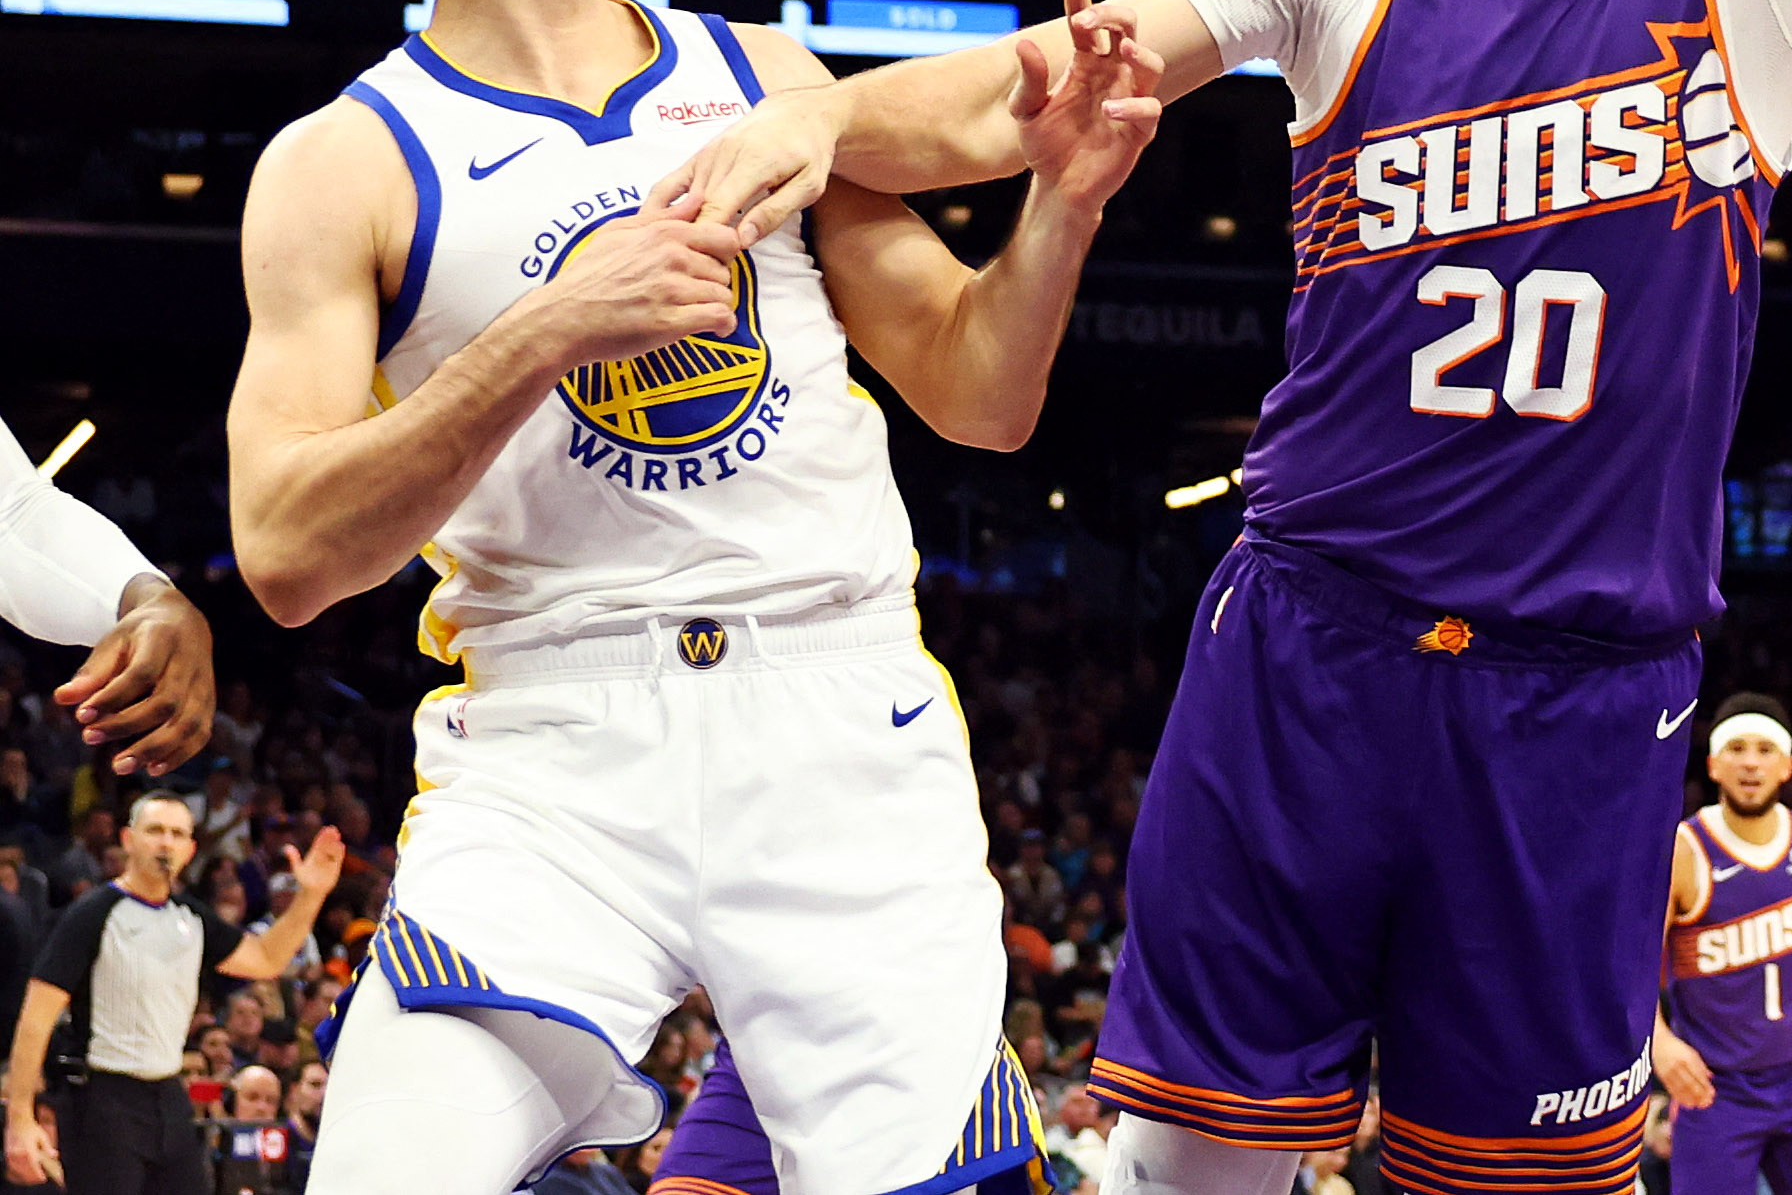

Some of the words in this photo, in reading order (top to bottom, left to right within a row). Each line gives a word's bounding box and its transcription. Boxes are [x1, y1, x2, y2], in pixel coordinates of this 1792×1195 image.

[656, 100, 746, 121] Rakuten
[520, 185, 641, 278] GOLDEN
[1410, 265, 1608, 422] 20
[568, 378, 790, 491] WARRIORS
[1764, 962, 1784, 1020] 1
[1530, 1035, 1652, 1126] PHOENI
